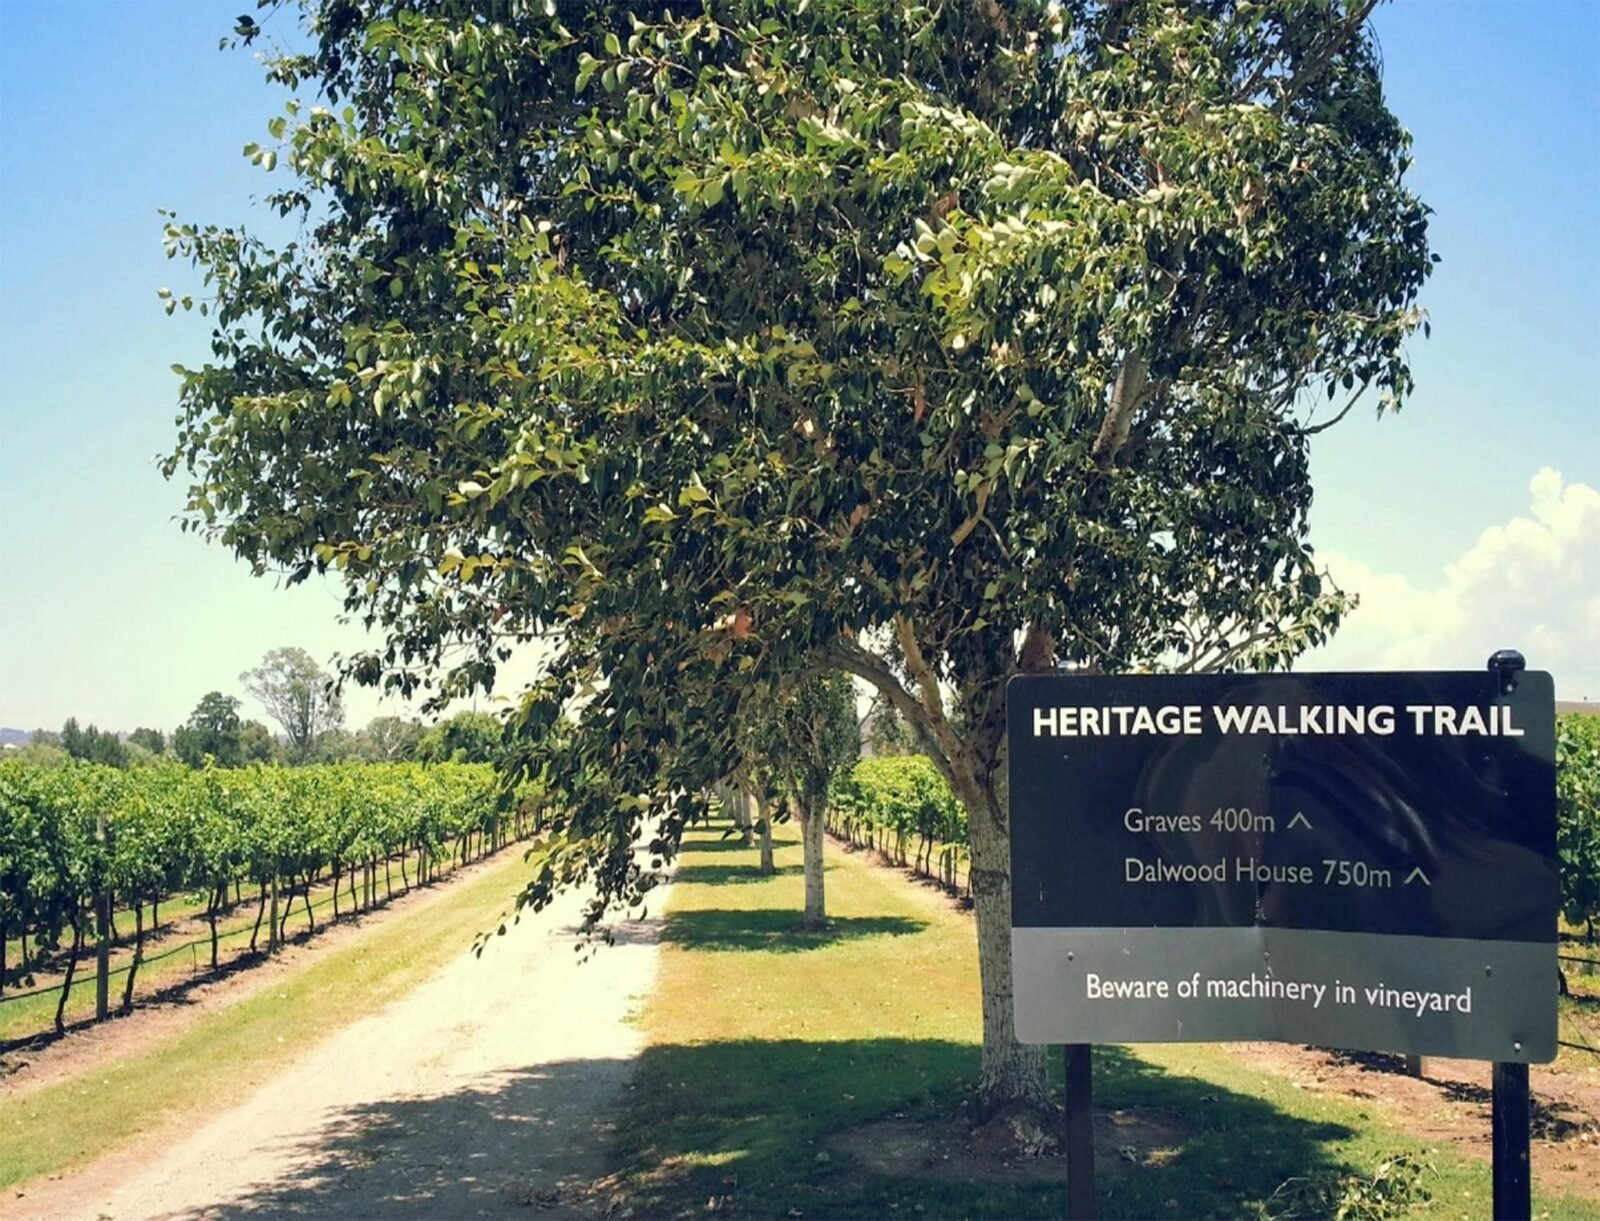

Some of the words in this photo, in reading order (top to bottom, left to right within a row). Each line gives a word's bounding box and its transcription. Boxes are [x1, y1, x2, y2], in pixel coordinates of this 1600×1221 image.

[1033, 706, 1202, 737] HERITAGE
[1212, 705, 1395, 735] WALKING
[1406, 705, 1525, 736] TRAIL
[1124, 808, 1202, 833] Graves
[1210, 808, 1275, 832] 400m
[1125, 858, 1226, 882] Dalwood
[1236, 858, 1313, 883] House
[1322, 860, 1391, 887] 750m
[1086, 973, 1169, 999] Beware
[1177, 972, 1202, 998] of
[1206, 972, 1326, 1009] machinery
[1335, 980, 1356, 1004] in
[1365, 983, 1471, 1017] vineyard
